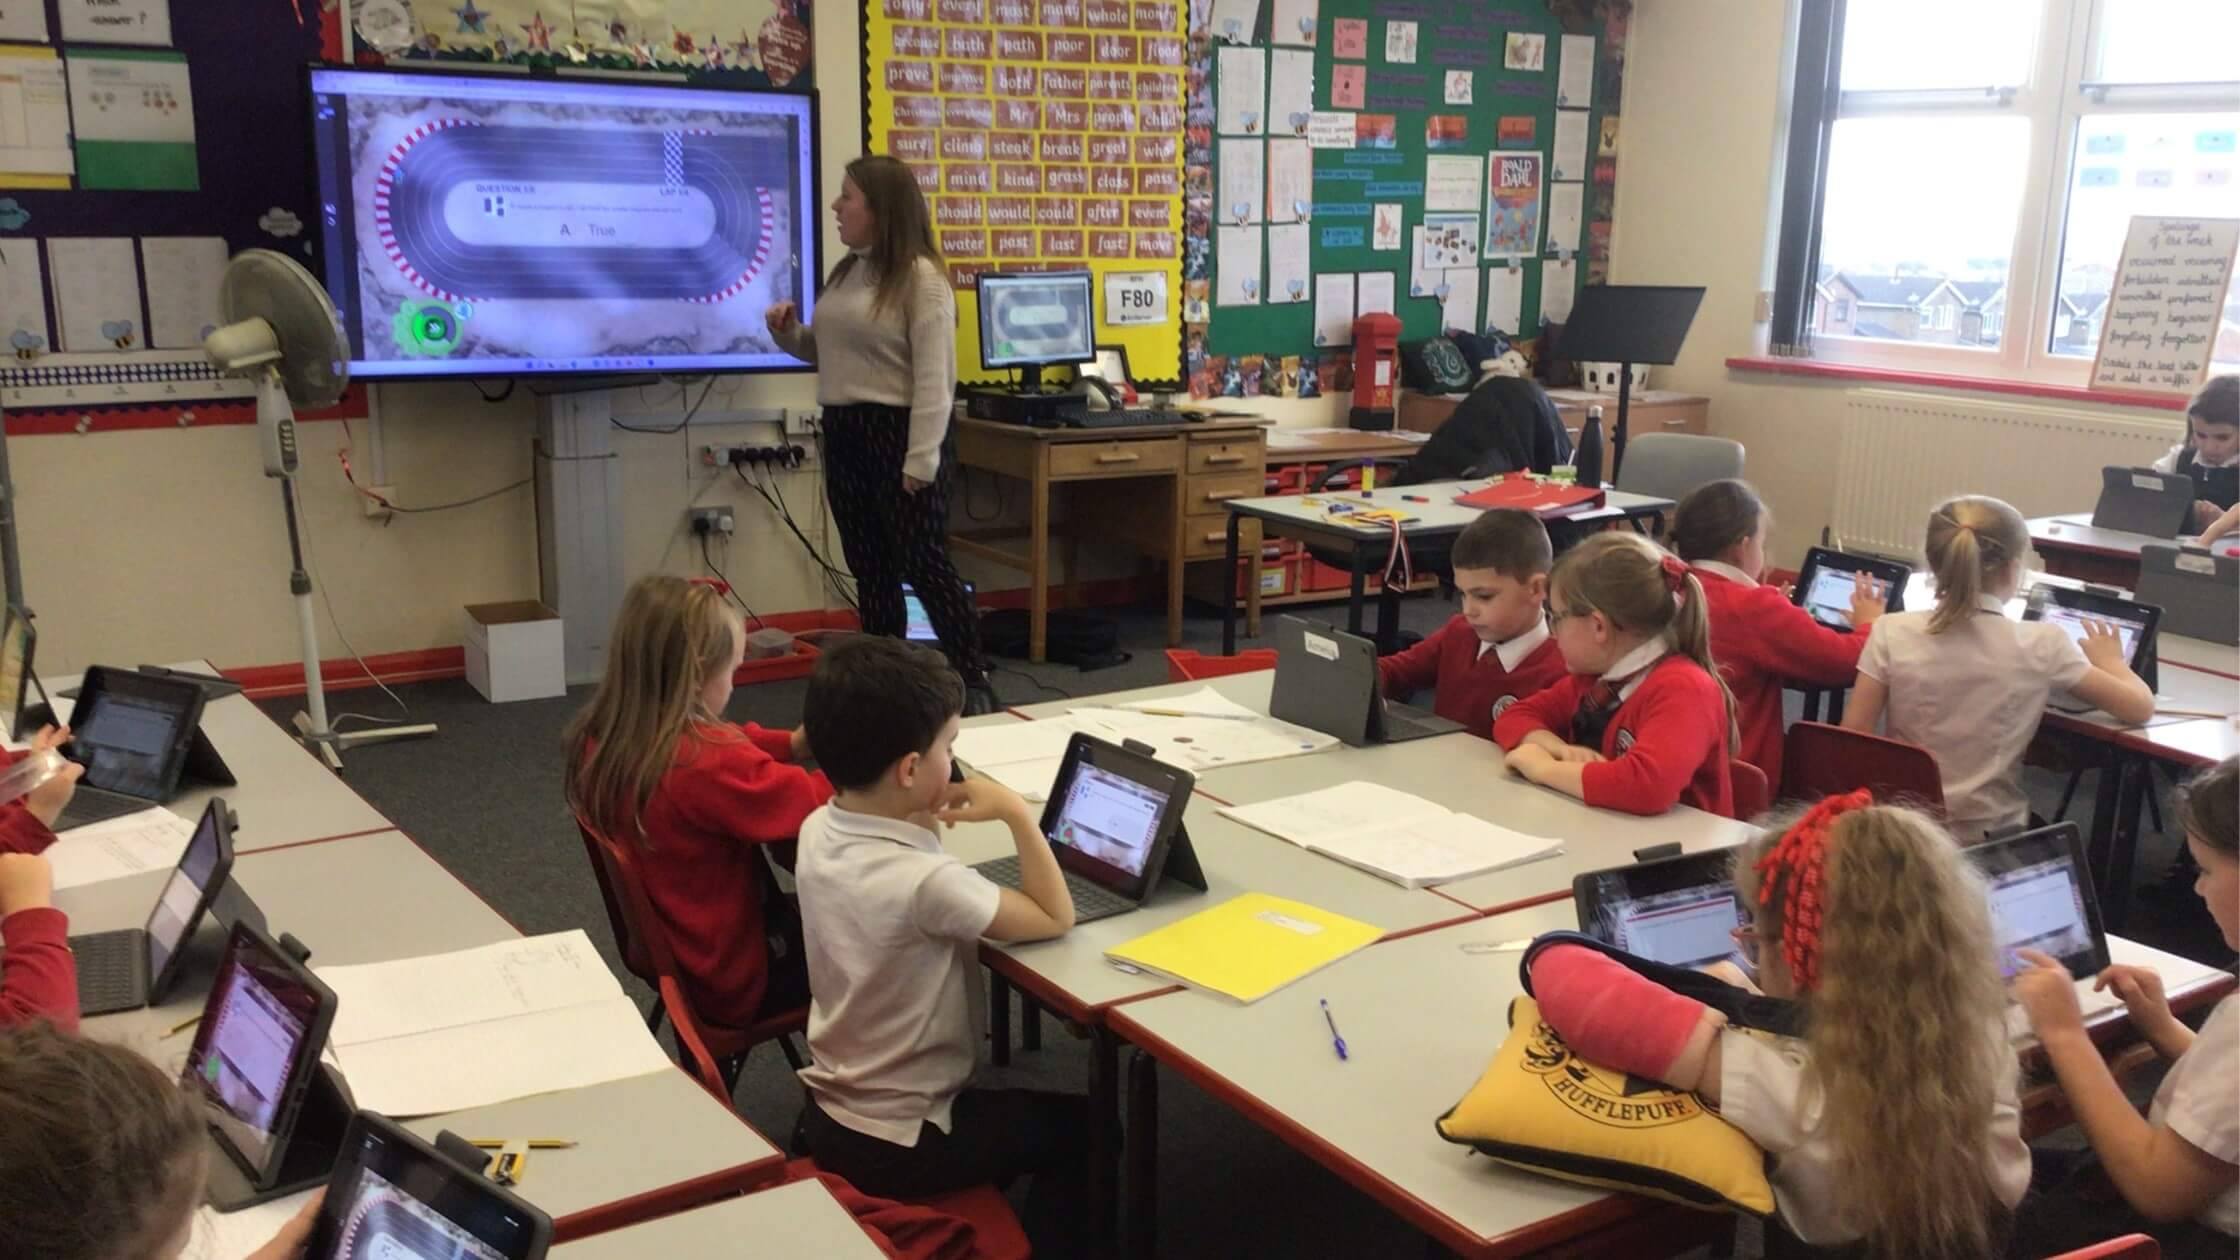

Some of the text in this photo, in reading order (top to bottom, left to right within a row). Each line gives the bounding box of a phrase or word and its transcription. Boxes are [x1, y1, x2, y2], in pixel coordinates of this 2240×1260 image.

[1088, 8, 1128, 24] whole
[1055, 40, 1084, 53] poor
[1101, 41, 1131, 58] door
[889, 68, 929, 84] prove
[1000, 73, 1031, 89] both
[1043, 72, 1084, 94] father
[1055, 107, 1080, 123] Mrs
[1144, 110, 1176, 126] child
[943, 137, 982, 153] climb
[993, 140, 1030, 154] steak
[1042, 140, 1080, 156] break
[1092, 140, 1127, 157] great
[950, 171, 986, 186] mind
[1003, 170, 1034, 186] kind
[1048, 171, 1085, 186] grass
[1097, 172, 1129, 189] class
[1144, 173, 1173, 188] pass
[1500, 172, 1532, 187] DAHL
[475, 184, 521, 193] QUESTION
[937, 203, 981, 219] should
[988, 204, 1030, 219] would
[1038, 204, 1074, 219] could
[1086, 203, 1119, 222] after
[560, 224, 617, 236] A True
[943, 239, 984, 251] water
[999, 235, 1028, 253] past
[1050, 235, 1075, 251] last
[1097, 234, 1125, 254] fast
[1121, 289, 1154, 309] F80
[1554, 1077, 1687, 1121] HUFFLEPUFF
